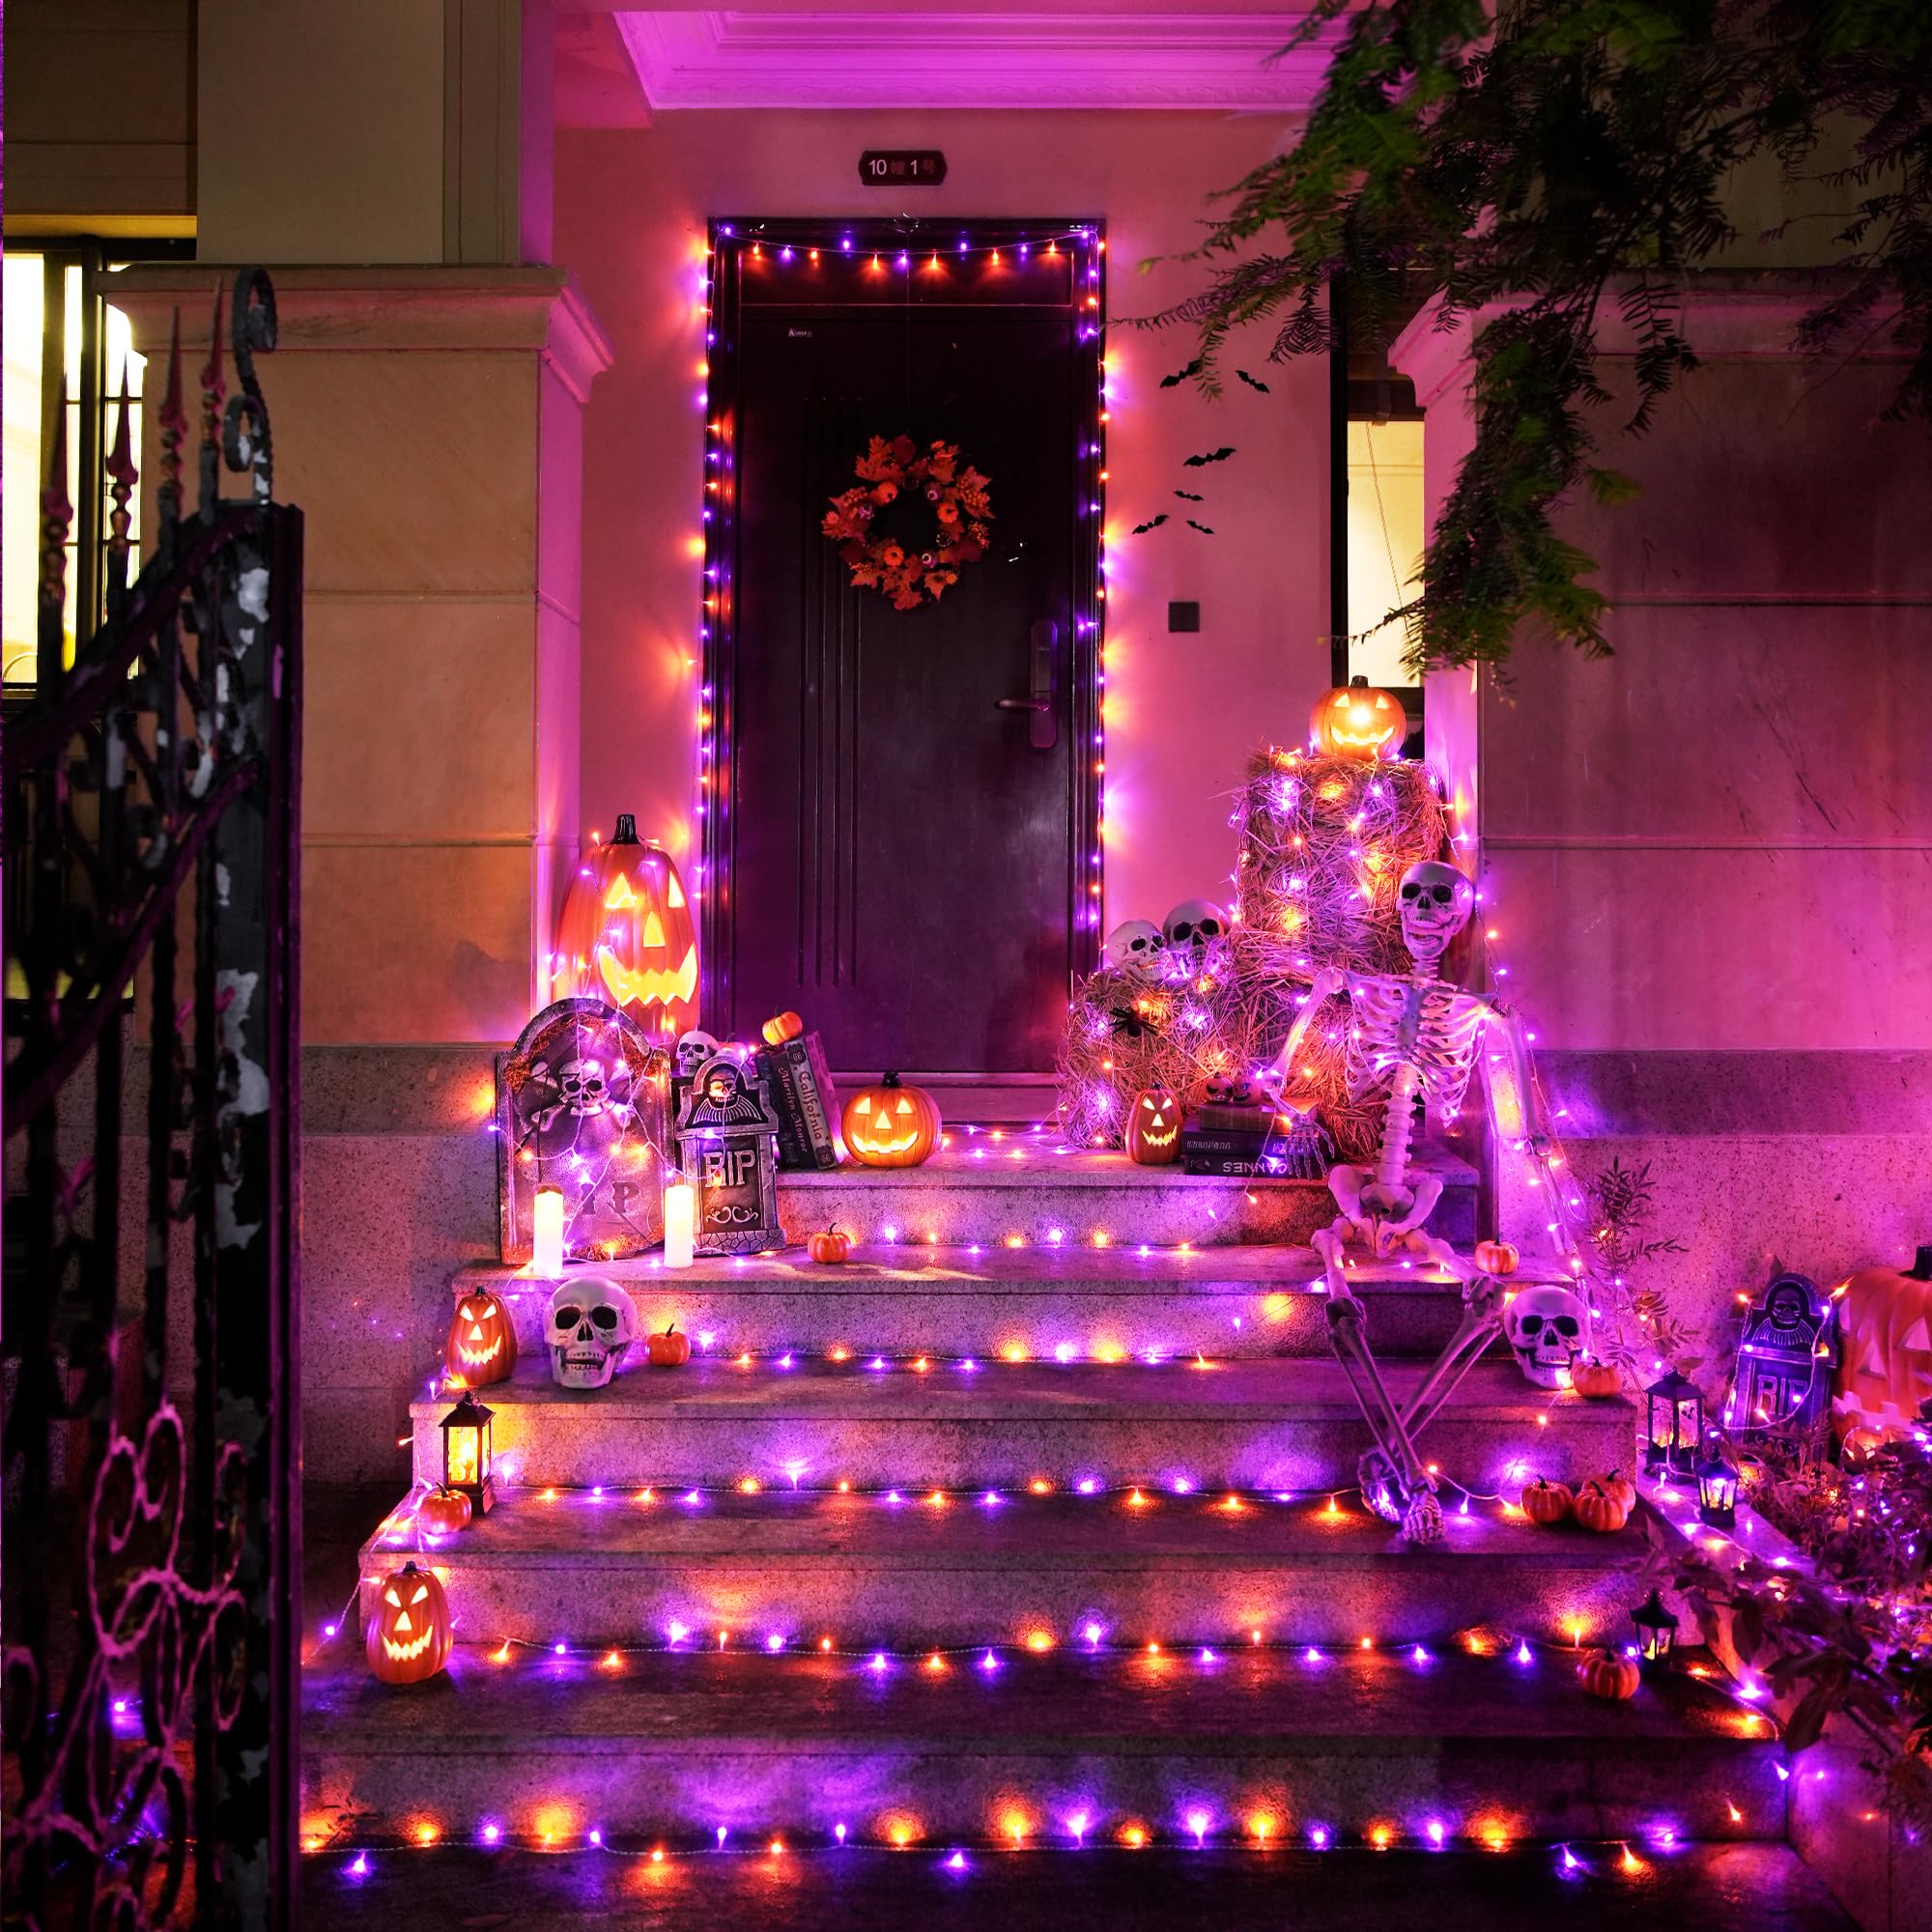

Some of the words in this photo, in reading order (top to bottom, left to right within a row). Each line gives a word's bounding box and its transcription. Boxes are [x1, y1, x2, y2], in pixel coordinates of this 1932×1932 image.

[868, 159, 888, 175] 10
[778, 1066, 796, 1110] Marilyn
[791, 1113, 808, 1152] Monroe
[799, 1071, 824, 1141] California
[702, 1150, 756, 1188] RIP
[1223, 1161, 1288, 1175] CANNES
[1755, 1375, 1808, 1417] RIP
